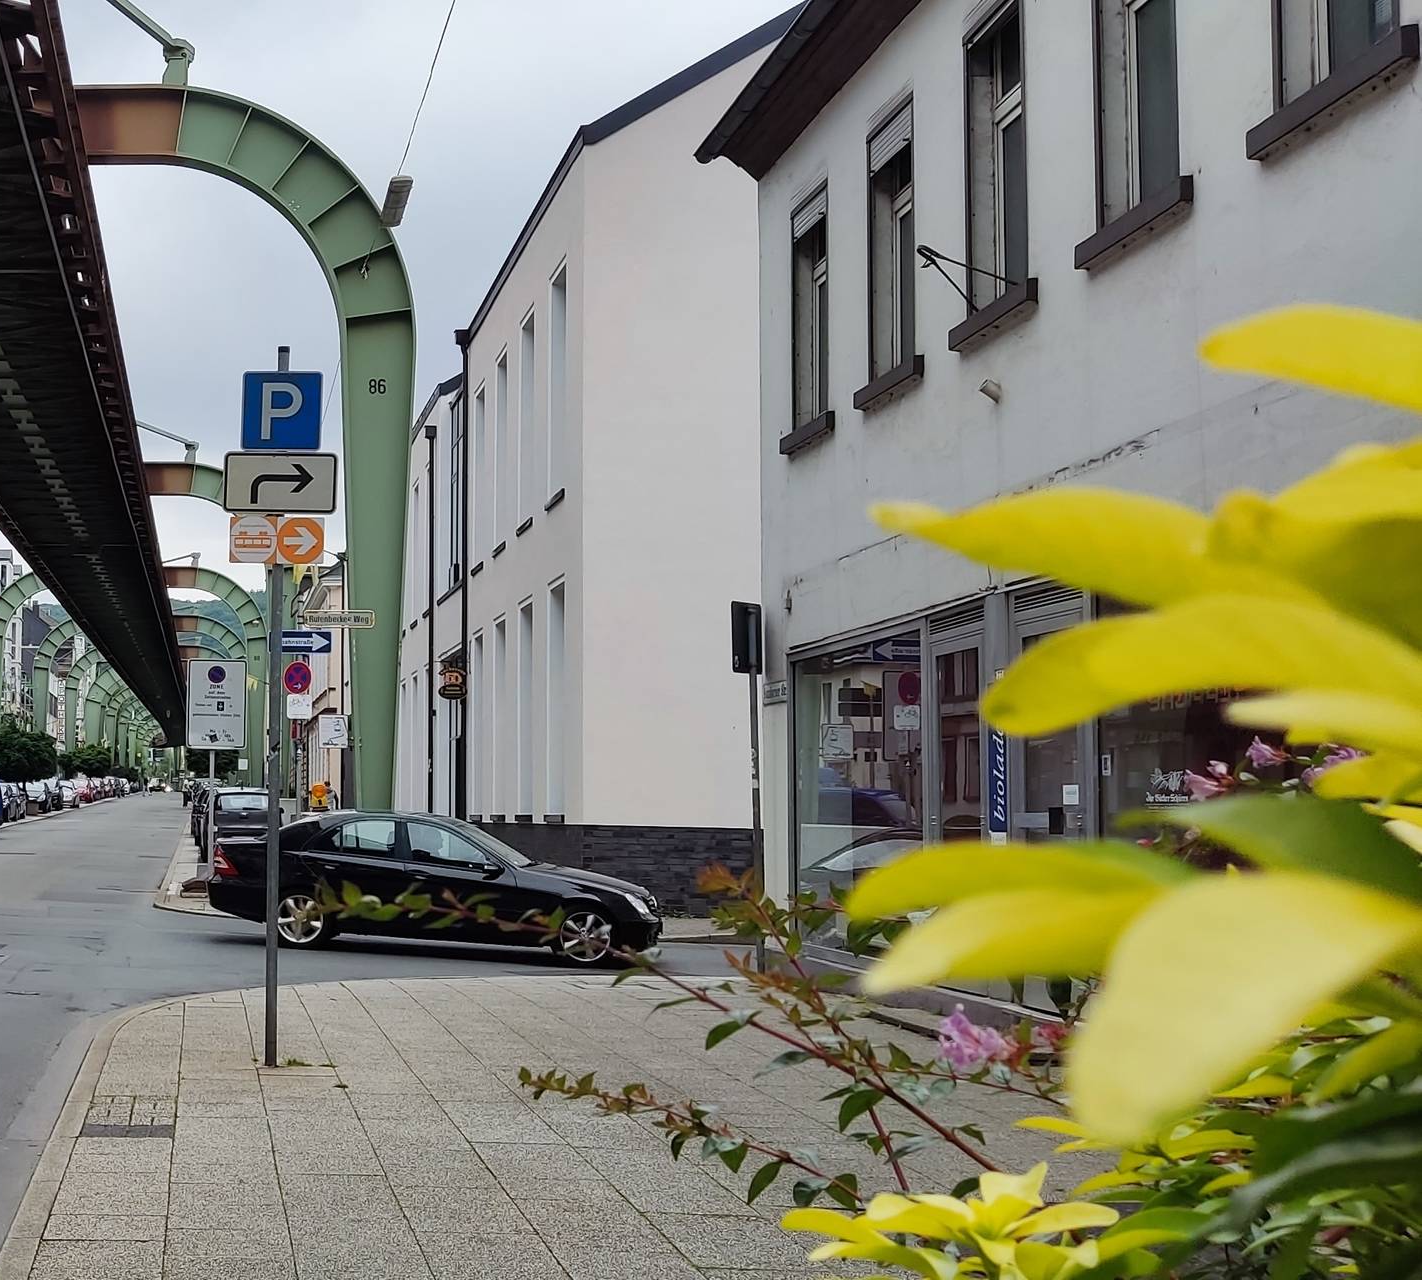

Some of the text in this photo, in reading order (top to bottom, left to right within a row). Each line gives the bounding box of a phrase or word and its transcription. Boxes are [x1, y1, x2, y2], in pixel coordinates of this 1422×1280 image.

[368, 379, 387, 394] 86
[260, 382, 304, 440] P
[353, 615, 369, 624] Weg
